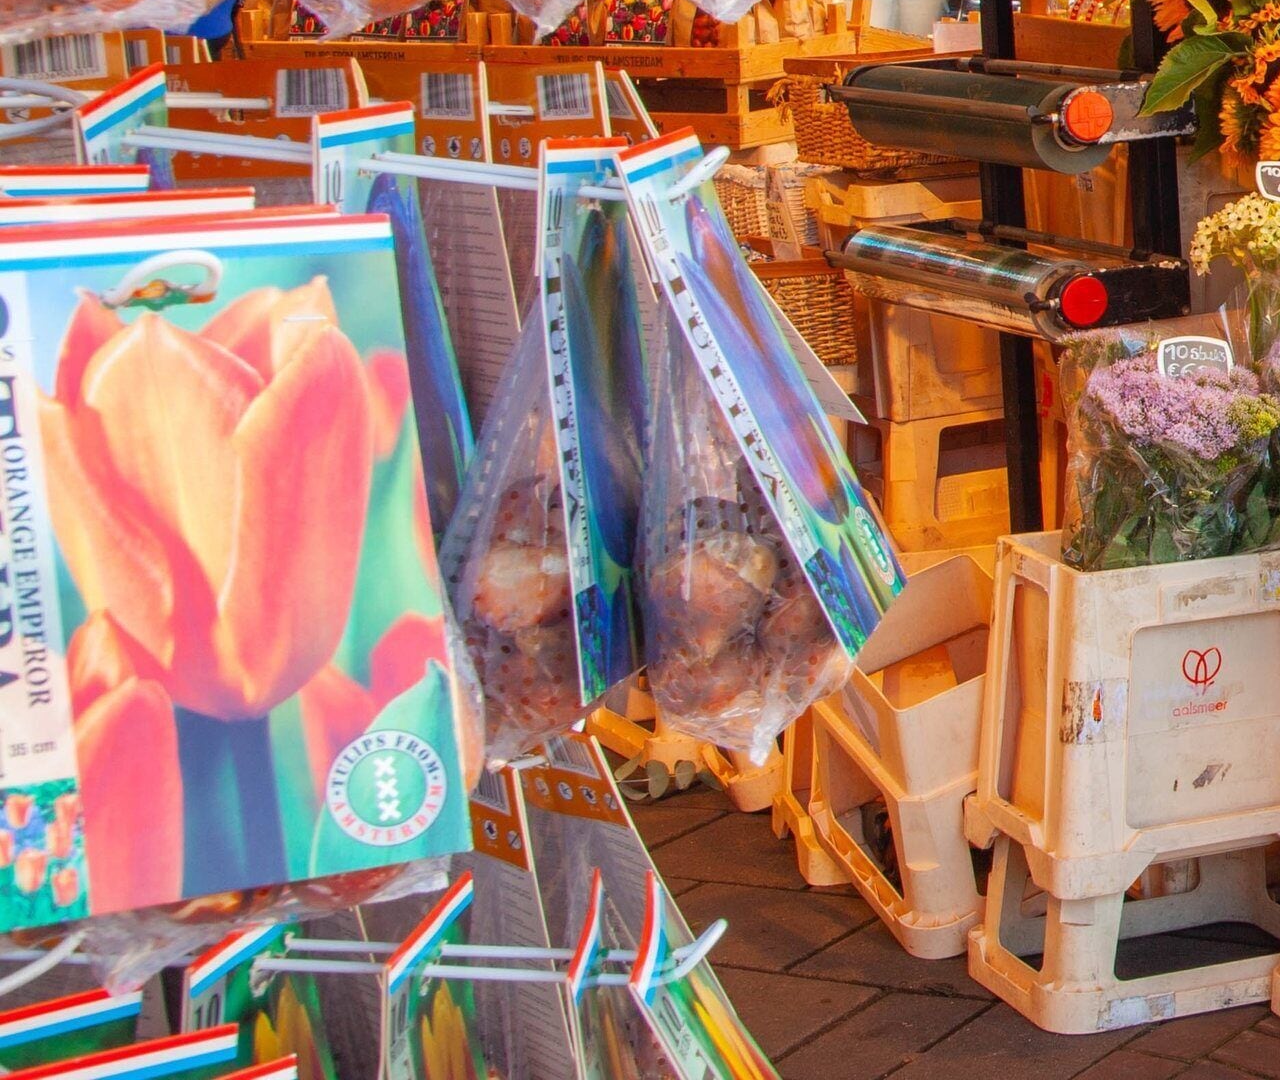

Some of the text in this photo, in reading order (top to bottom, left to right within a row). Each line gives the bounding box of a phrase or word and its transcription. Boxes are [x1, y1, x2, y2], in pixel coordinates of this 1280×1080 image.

[356, 51, 405, 61] AMSTERDAM
[611, 55, 663, 67] AMSTERDAM
[1164, 344, 1227, 363] 10 stuks
[2, 439, 38, 562] ORANGE
[14, 567, 54, 709] EMPEROR
[1173, 699, 1228, 717] aalsmeer
[29, 739, 57, 754] cm
[331, 735, 442, 790] TULIPS FROM
[333, 776, 444, 842] AMSTERDAM
